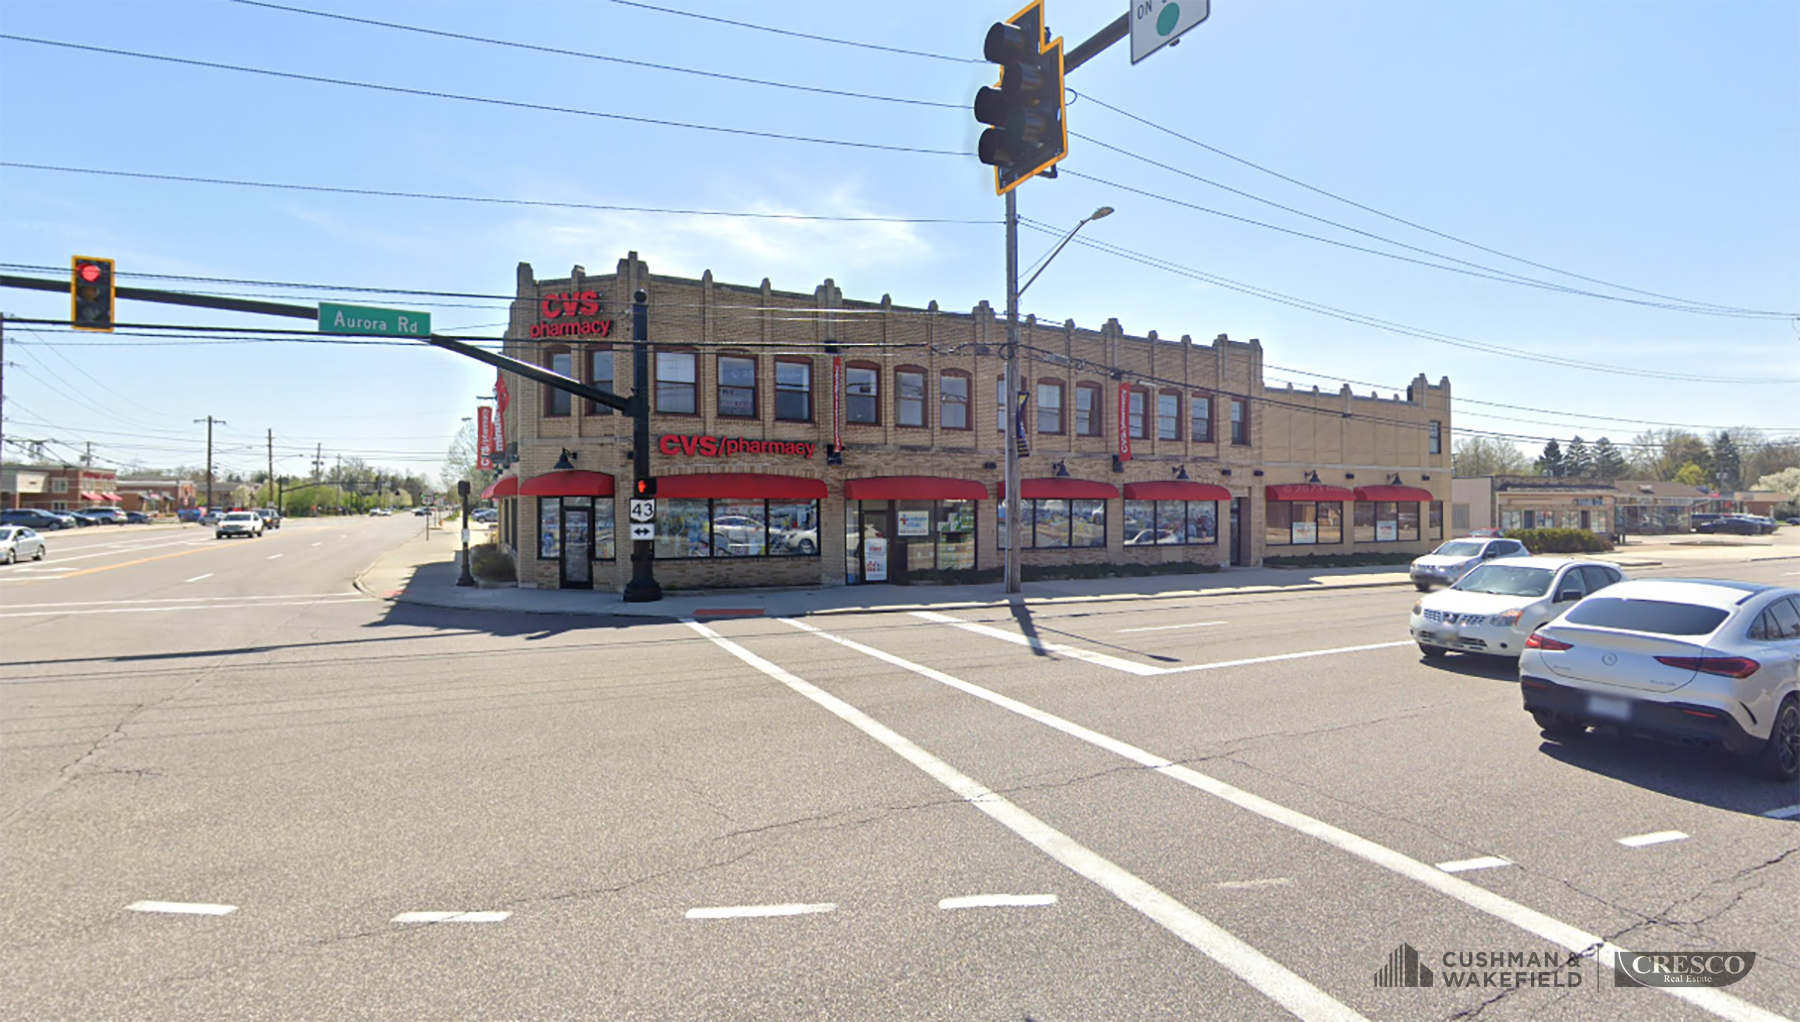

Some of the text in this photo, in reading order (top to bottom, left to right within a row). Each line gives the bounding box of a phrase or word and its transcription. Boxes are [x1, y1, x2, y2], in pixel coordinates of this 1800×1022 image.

[1137, 0, 1152, 20] ON
[541, 288, 599, 319] CVS
[334, 310, 418, 333] Aurora Rd
[530, 320, 611, 338] pharmacy
[632, 502, 654, 517] 43
